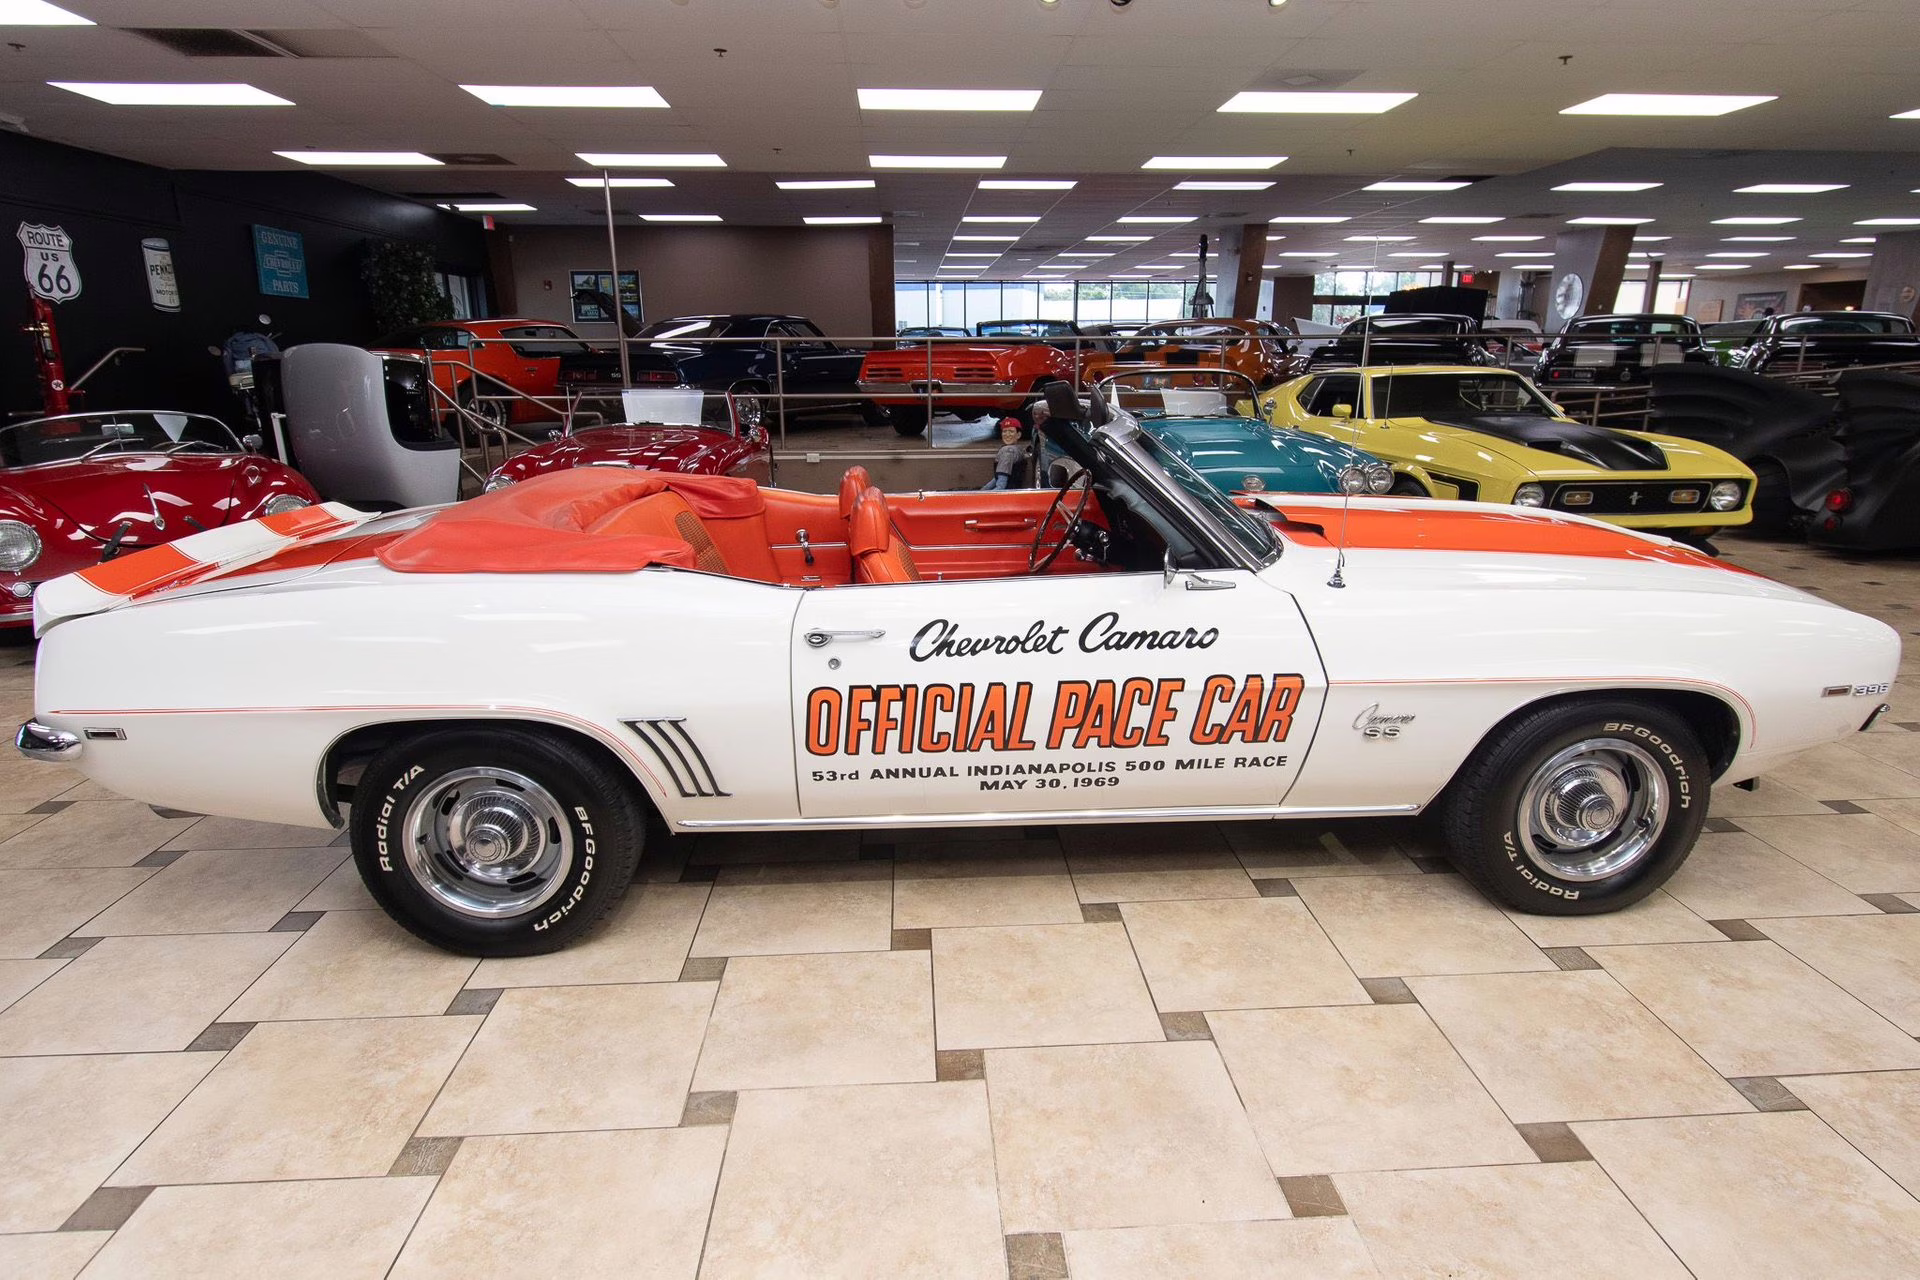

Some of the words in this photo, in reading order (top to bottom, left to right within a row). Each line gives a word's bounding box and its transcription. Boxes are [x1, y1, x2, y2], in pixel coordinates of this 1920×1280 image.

[26, 230, 65, 248] ROUTE
[261, 231, 298, 249] GENUINE
[40, 251, 60, 262] US
[38, 263, 71, 294] 66
[272, 279, 299, 293] PARTS
[909, 618, 1069, 662] Chevrolet
[1078, 611, 1219, 653] Camaro
[805, 681, 1036, 756] OFFICIAL
[1045, 676, 1186, 750] PACE
[1189, 673, 1306, 745] CAR
[1352, 702, 1416, 729] Camaro
[1363, 725, 1401, 740] SS
[812, 769, 860, 782] 53rd
[870, 766, 959, 780] ANNUAL
[967, 761, 1117, 777] INDIANAPOLIS
[1125, 759, 1166, 772] 500
[1174, 757, 1226, 770] MILE
[1233, 755, 1288, 768] RACE
[1603, 722, 1692, 808] BFGoodrich
[979, 779, 1028, 791] MAY
[1073, 776, 1120, 788] 1969
[376, 795, 394, 872] Radial
[393, 765, 425, 790] T/A
[1503, 831, 1518, 862] T/A
[534, 806, 596, 931] BFGoodrich
[1515, 864, 1580, 900] Radial
